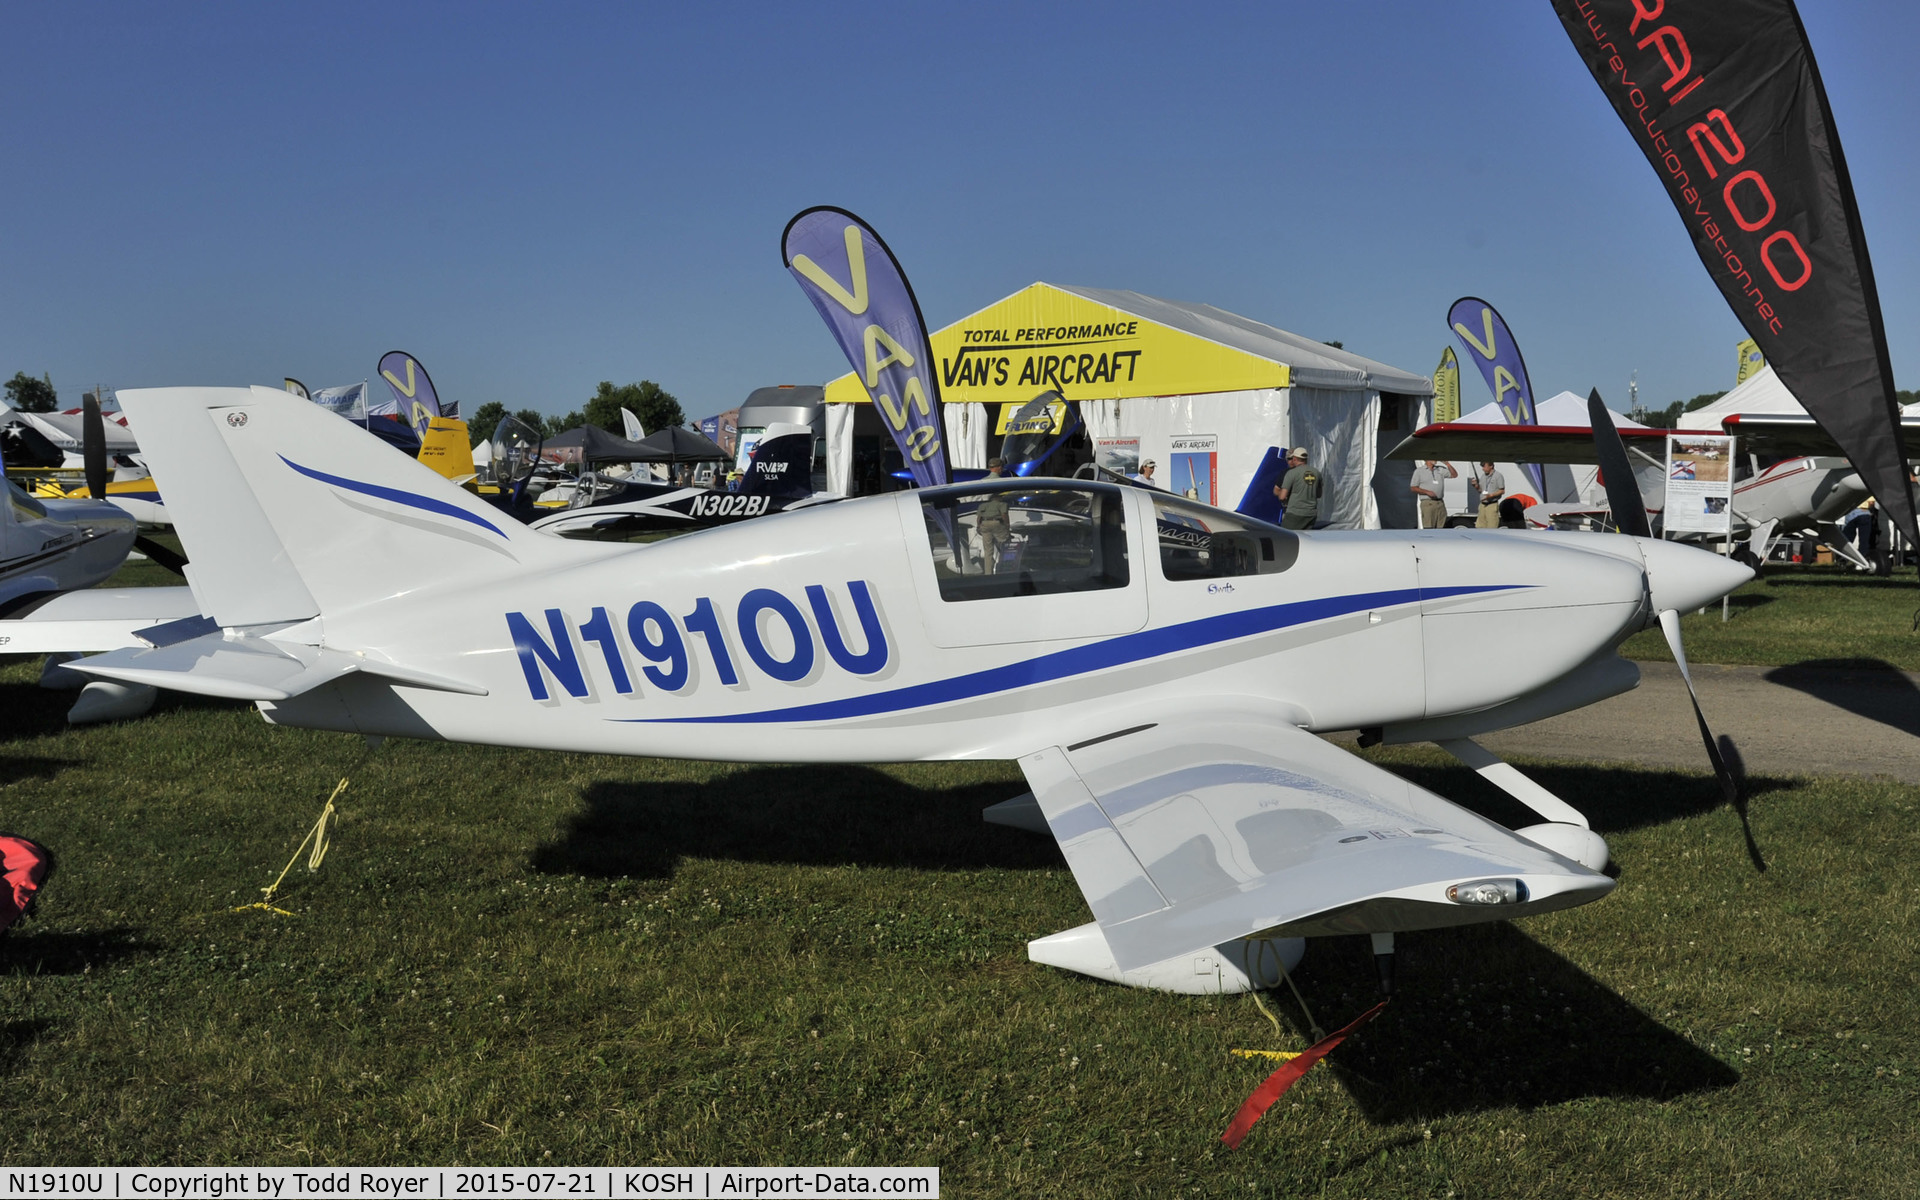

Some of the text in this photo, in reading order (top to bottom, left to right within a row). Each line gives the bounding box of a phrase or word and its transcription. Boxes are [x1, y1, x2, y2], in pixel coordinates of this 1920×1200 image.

[1687, 109, 1811, 291] 200
[964, 321, 1138, 343] TOTAL PERFORMANCE
[943, 347, 1142, 393] VAN'S AIRCRAFT
[1171, 440, 1216, 450] VAN'S AIRCRAFT
[688, 495, 771, 516] N302BJ
[505, 580, 894, 703] N1910U
